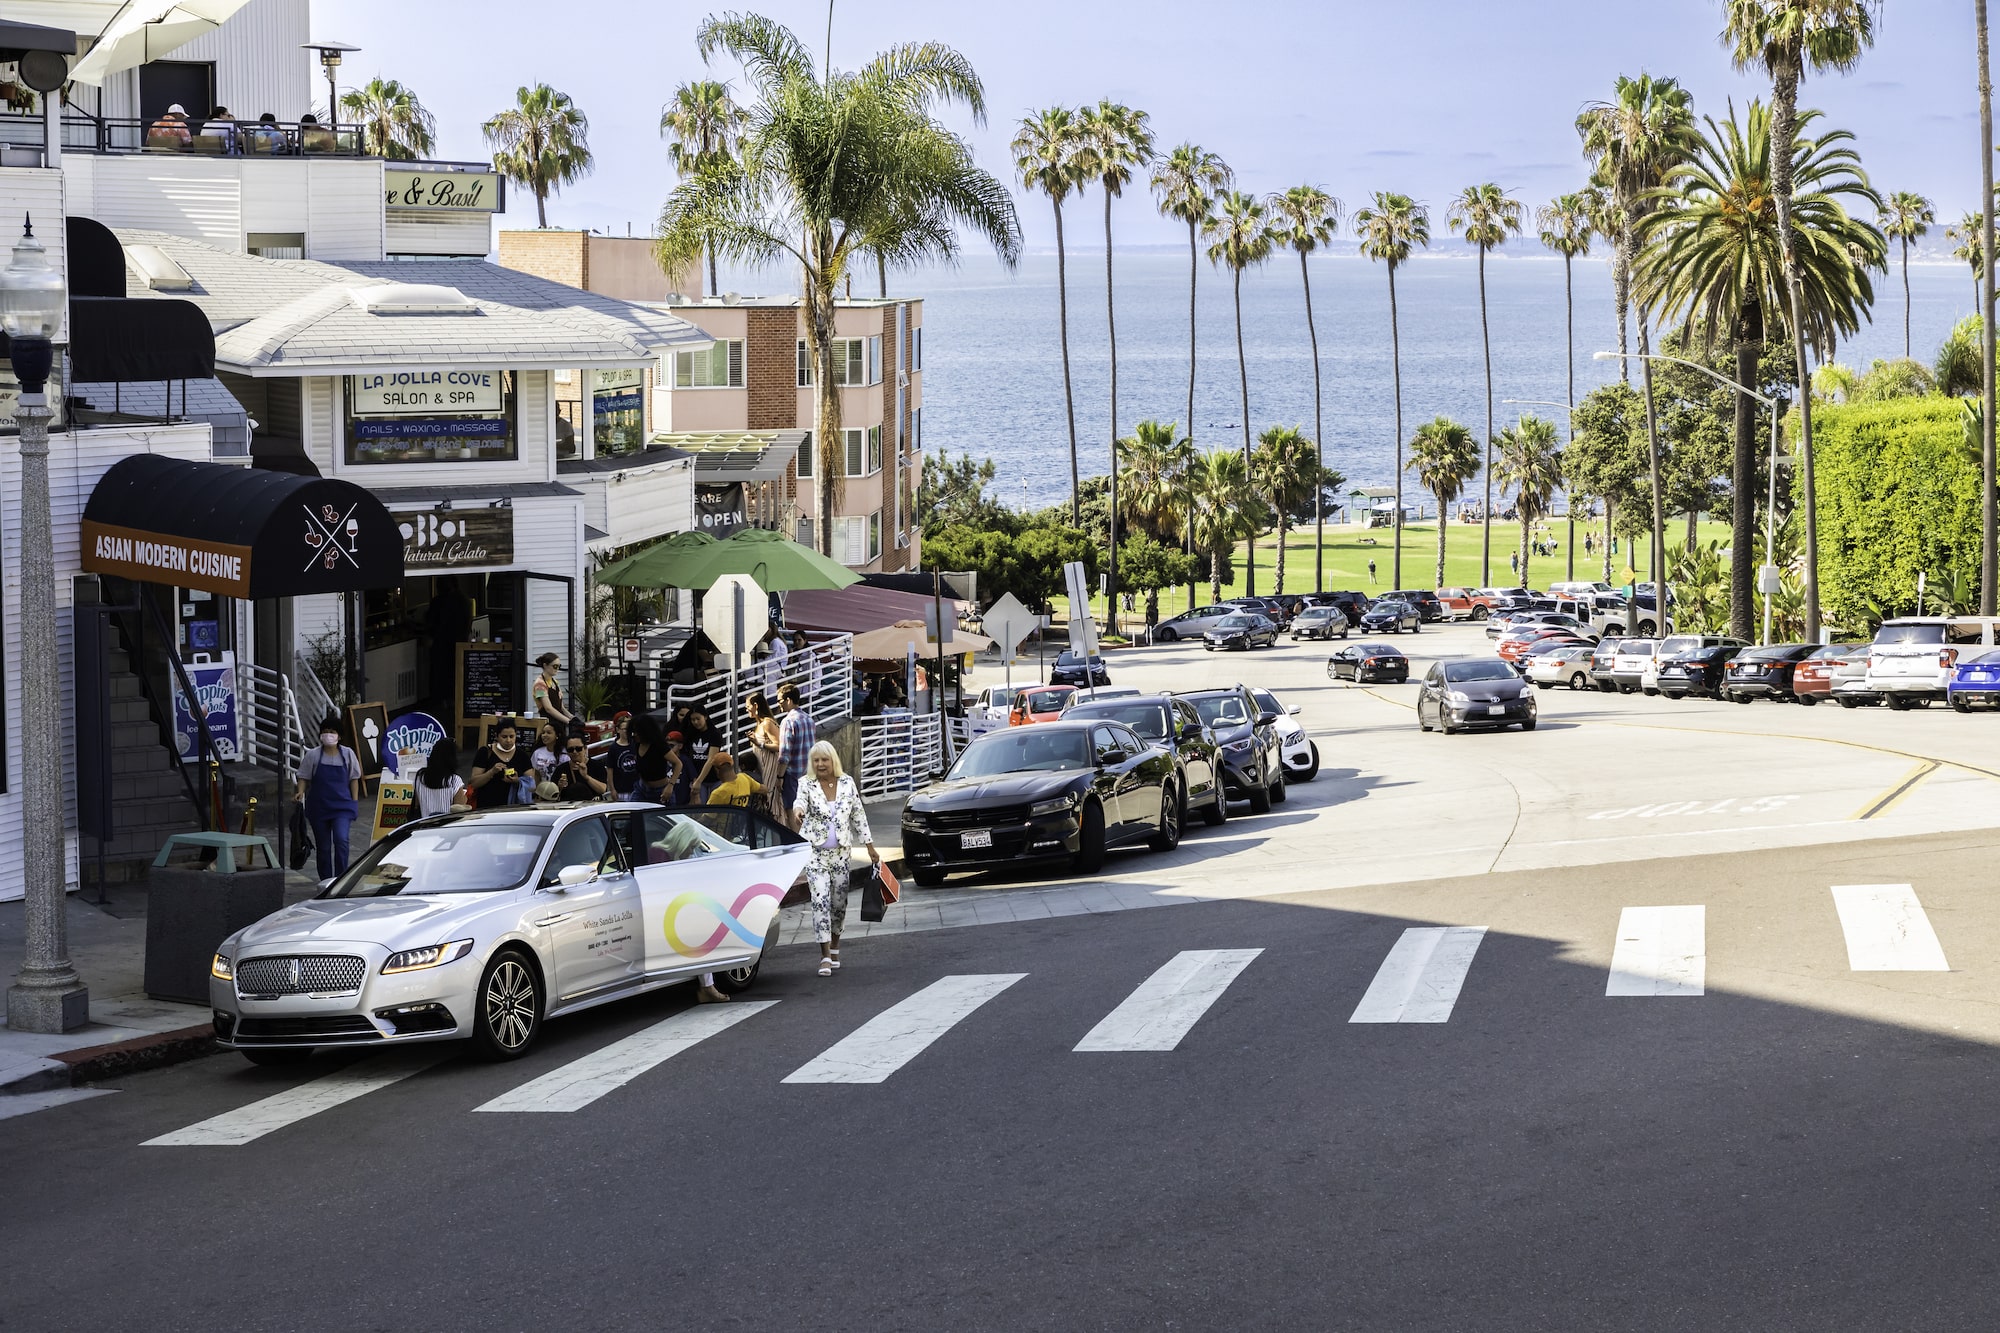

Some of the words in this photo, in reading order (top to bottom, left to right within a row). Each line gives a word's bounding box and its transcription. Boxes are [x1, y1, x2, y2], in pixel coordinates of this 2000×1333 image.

[404, 177, 425, 205] &
[427, 179, 483, 207] Basil
[363, 375, 383, 390] LA
[390, 371, 441, 386] JOLLA
[448, 372, 491, 387] COVE
[383, 392, 428, 405] SALON
[434, 393, 444, 404] &
[449, 391, 475, 404] SPA
[361, 424, 393, 434] NAILS
[402, 423, 441, 433] WAXING
[450, 423, 500, 432] MASSAGE
[701, 493, 722, 504] ARE
[703, 511, 742, 528] OPEN
[95, 535, 132, 562] ASIAN
[135, 540, 187, 571] MODERN
[190, 549, 241, 581] CUISINE
[447, 540, 487, 565] Gelato
[383, 788, 399, 799] Dr.
[401, 788, 414, 801] Ju
